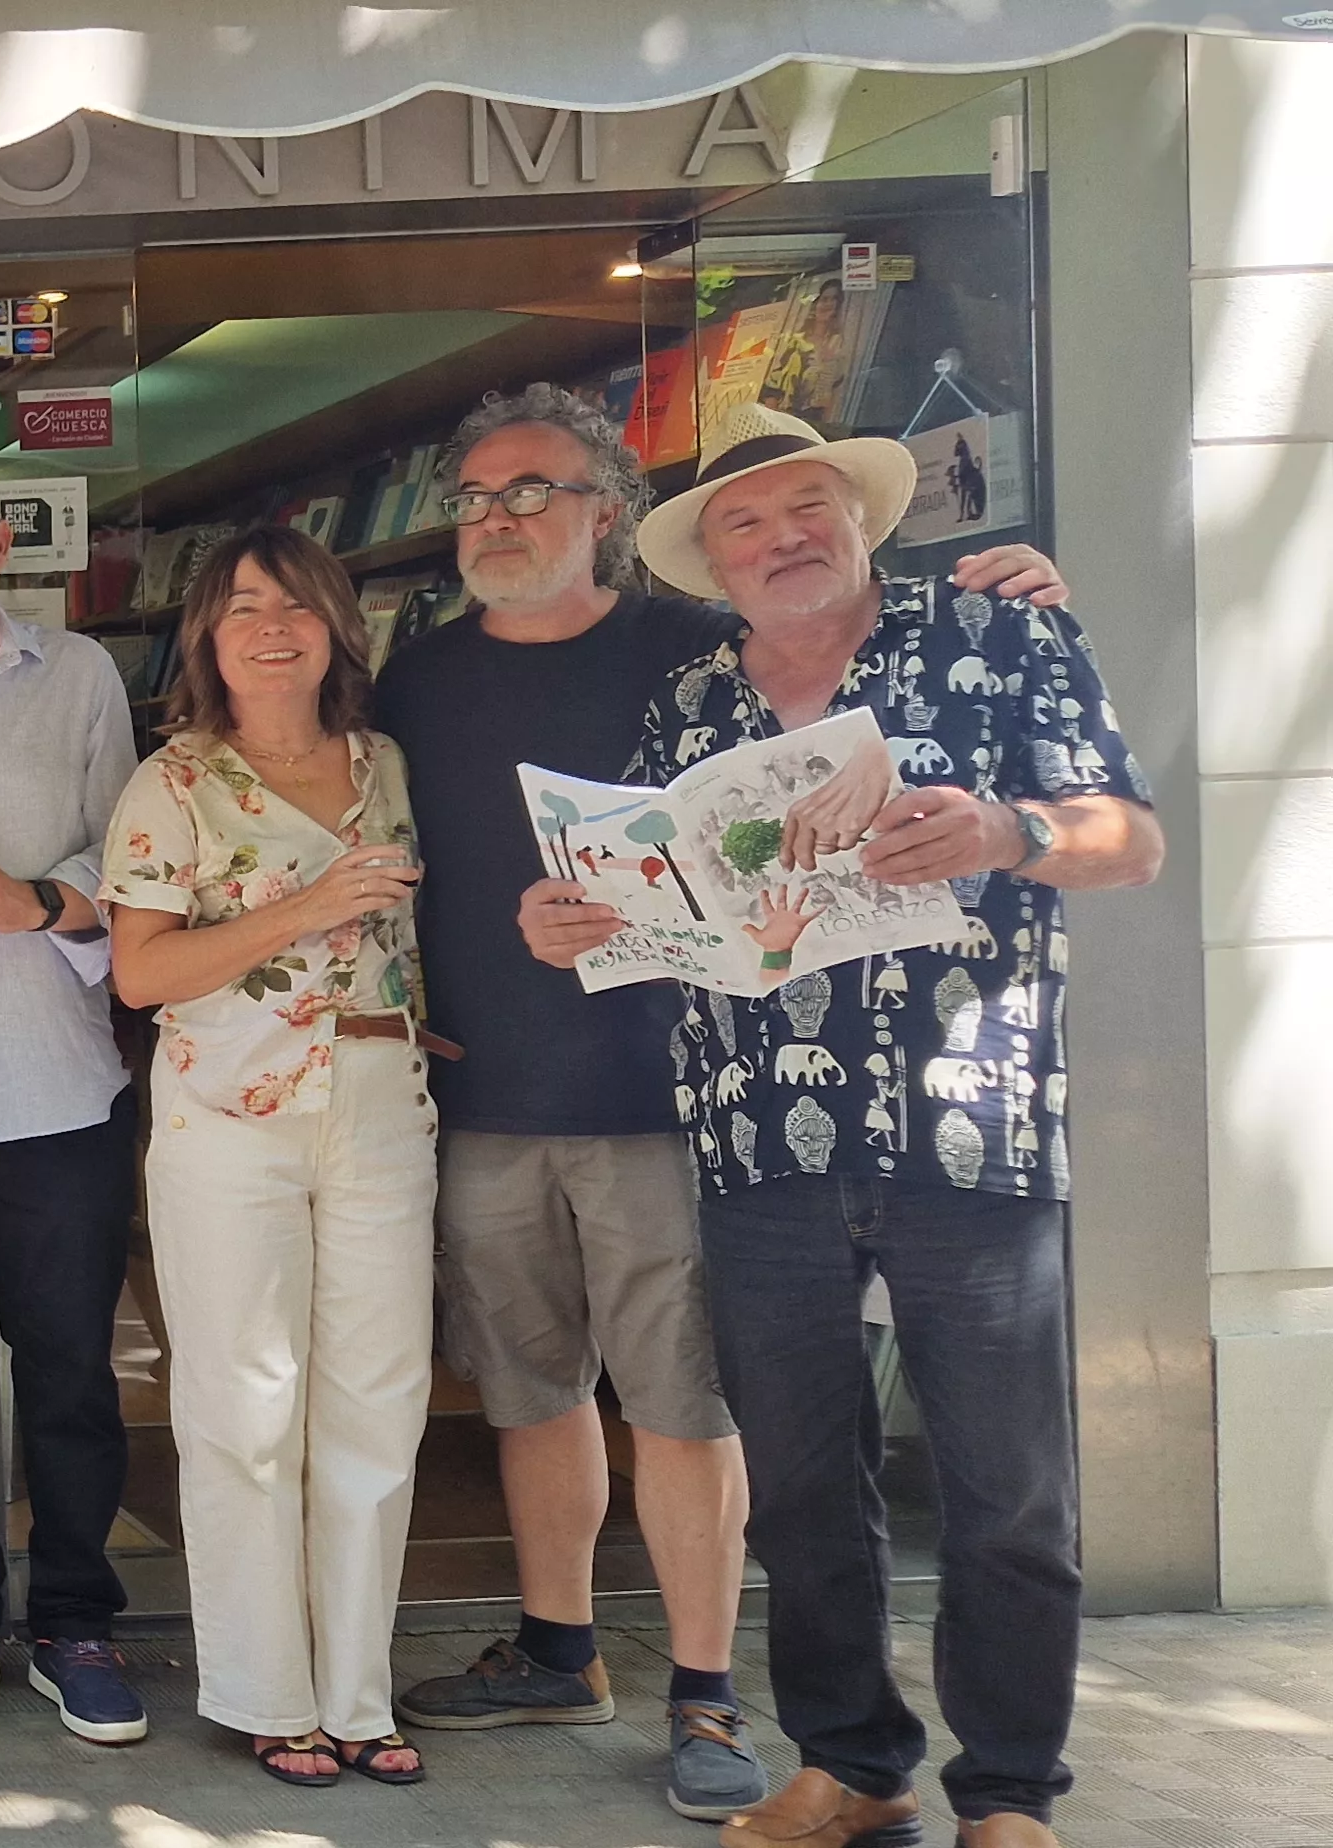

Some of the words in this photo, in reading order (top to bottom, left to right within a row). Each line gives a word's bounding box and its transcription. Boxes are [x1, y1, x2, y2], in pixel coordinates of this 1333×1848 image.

[50, 408, 108, 421] COMERCIO
[51, 419, 108, 433] HUESCA
[4, 502, 39, 514] BONO
[5, 513, 38, 524] CULT
[817, 897, 947, 938] LORENZO
